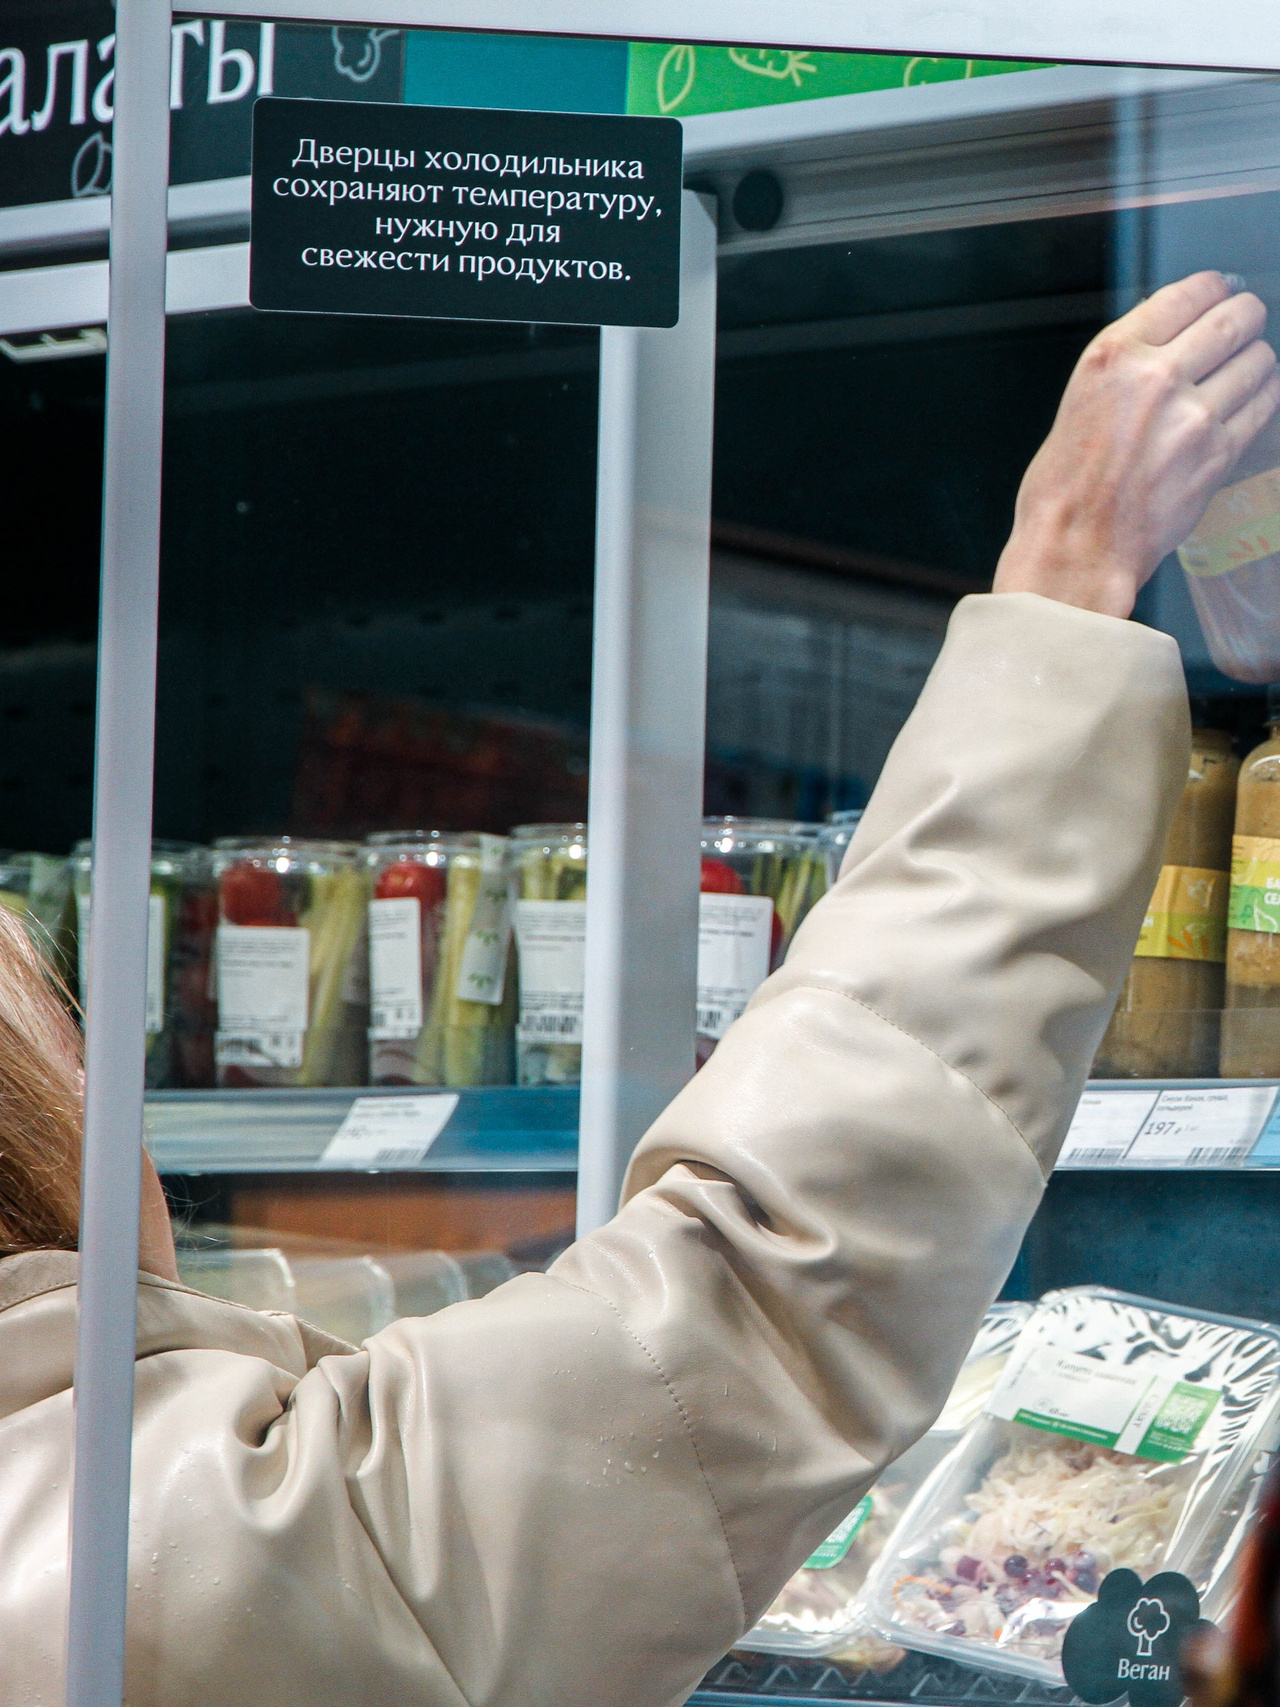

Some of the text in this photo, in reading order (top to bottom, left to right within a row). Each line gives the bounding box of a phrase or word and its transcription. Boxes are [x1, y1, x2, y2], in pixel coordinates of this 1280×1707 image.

[292, 138, 645, 180] Дверцы холодильника
[272, 174, 663, 219] сохраняют температуру,
[375, 214, 561, 246] нужную для
[301, 245, 632, 287] свежести продуктов.
[1144, 1121, 1176, 1135] 197
[1117, 1657, 1171, 1681] Веган
